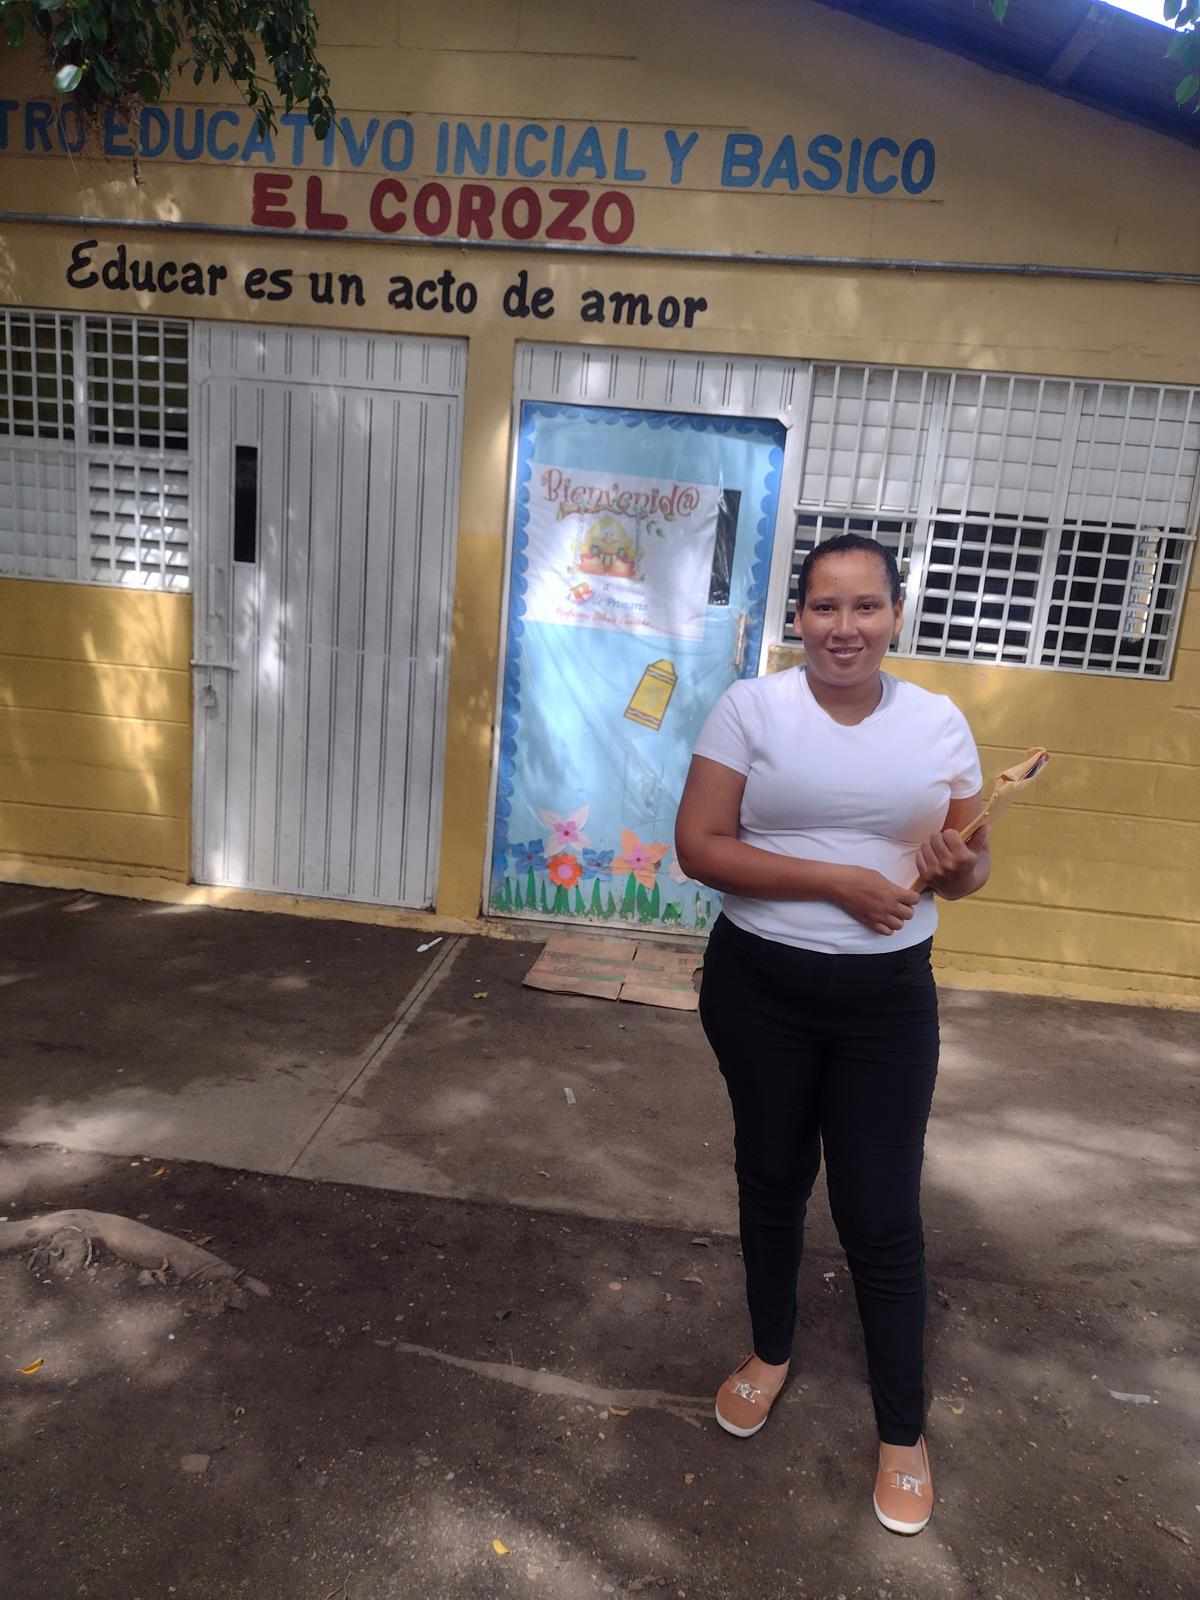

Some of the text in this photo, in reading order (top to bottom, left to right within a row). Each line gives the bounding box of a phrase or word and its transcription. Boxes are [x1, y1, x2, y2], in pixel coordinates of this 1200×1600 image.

[105, 106, 413, 171] EDUCATIVO
[436, 121, 645, 179] INICIAL
[663, 130, 699, 184] Y
[720, 133, 936, 194] BASICO
[251, 172, 635, 245] EL COROZO
[66, 240, 708, 329] Educar es un acto de amor
